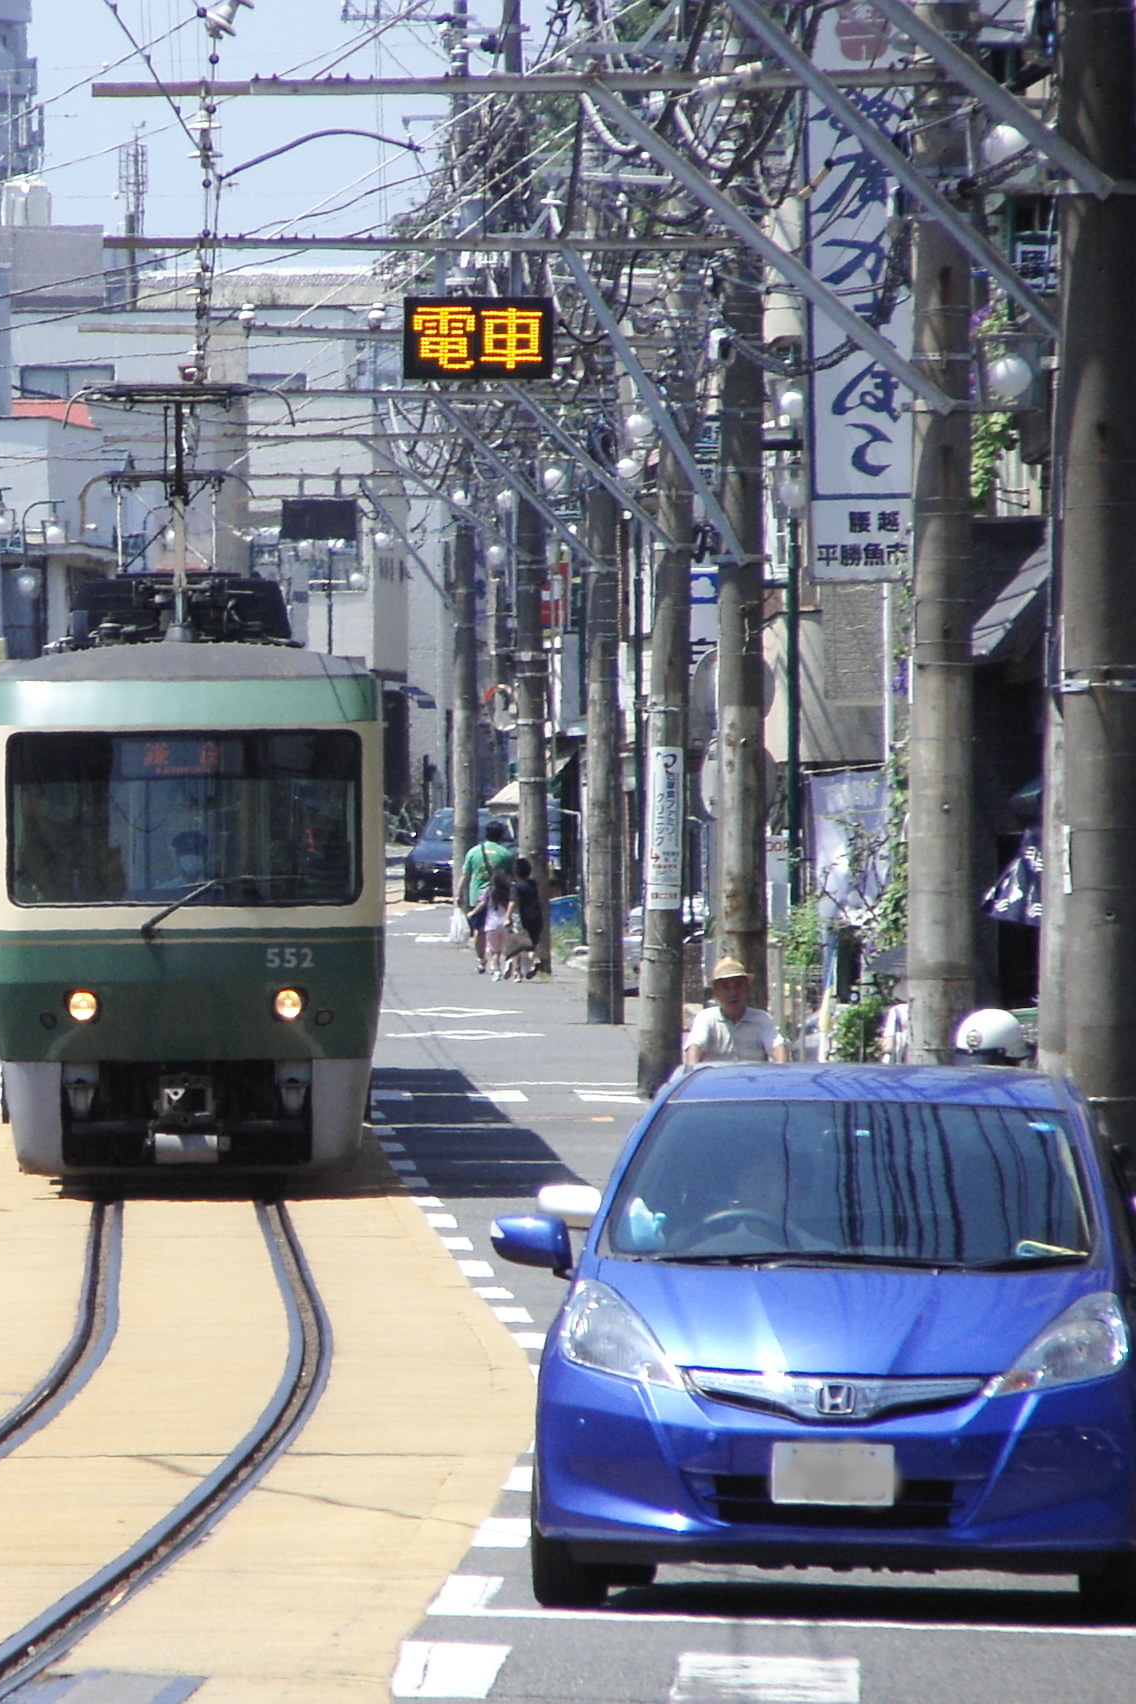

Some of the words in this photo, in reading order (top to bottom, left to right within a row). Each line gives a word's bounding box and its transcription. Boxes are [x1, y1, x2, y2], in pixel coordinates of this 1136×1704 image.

[412, 306, 543, 370] 電車
[849, 511, 900, 532] 腰越
[266, 948, 315, 968] 552
